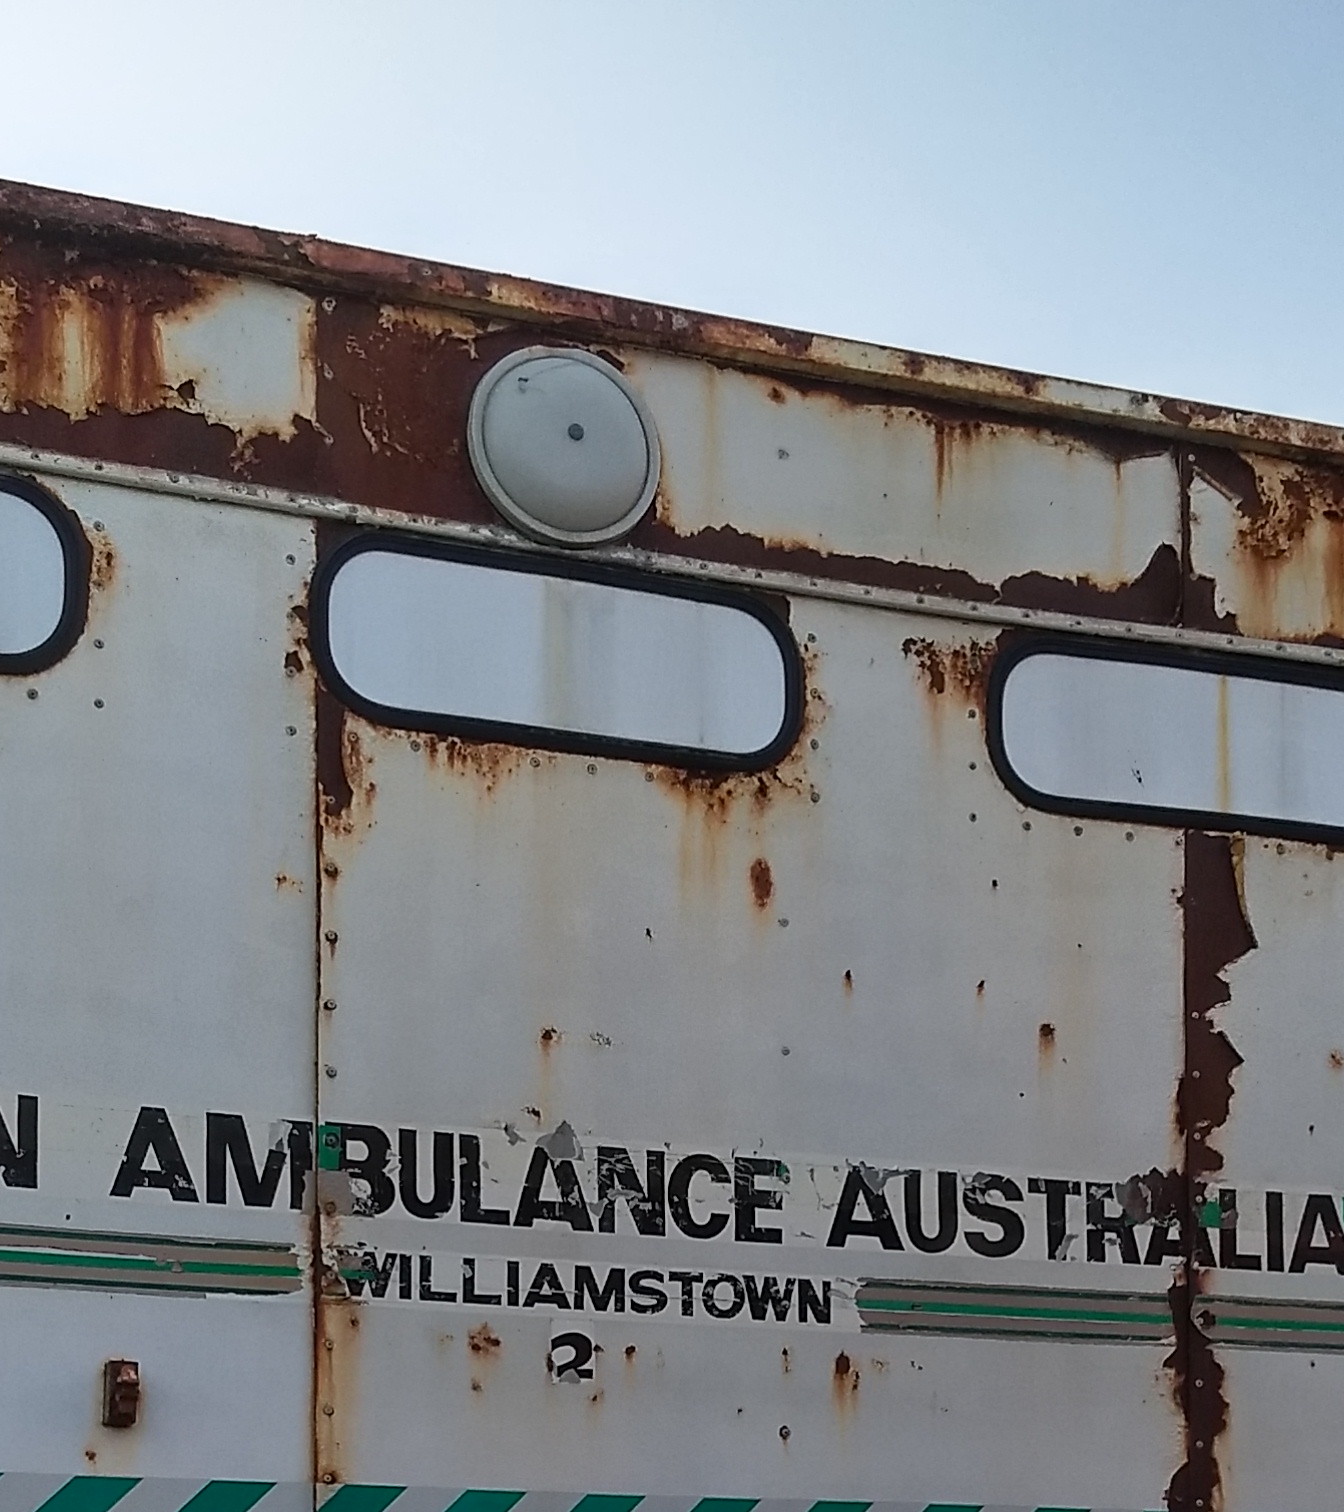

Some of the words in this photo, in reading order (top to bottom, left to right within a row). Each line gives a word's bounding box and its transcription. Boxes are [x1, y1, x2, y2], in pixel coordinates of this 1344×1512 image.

[109, 1106, 784, 1245] AMBULANCE
[337, 1249, 832, 1324] WILLIAMSTOWN
[550, 1332, 594, 1380] 2
